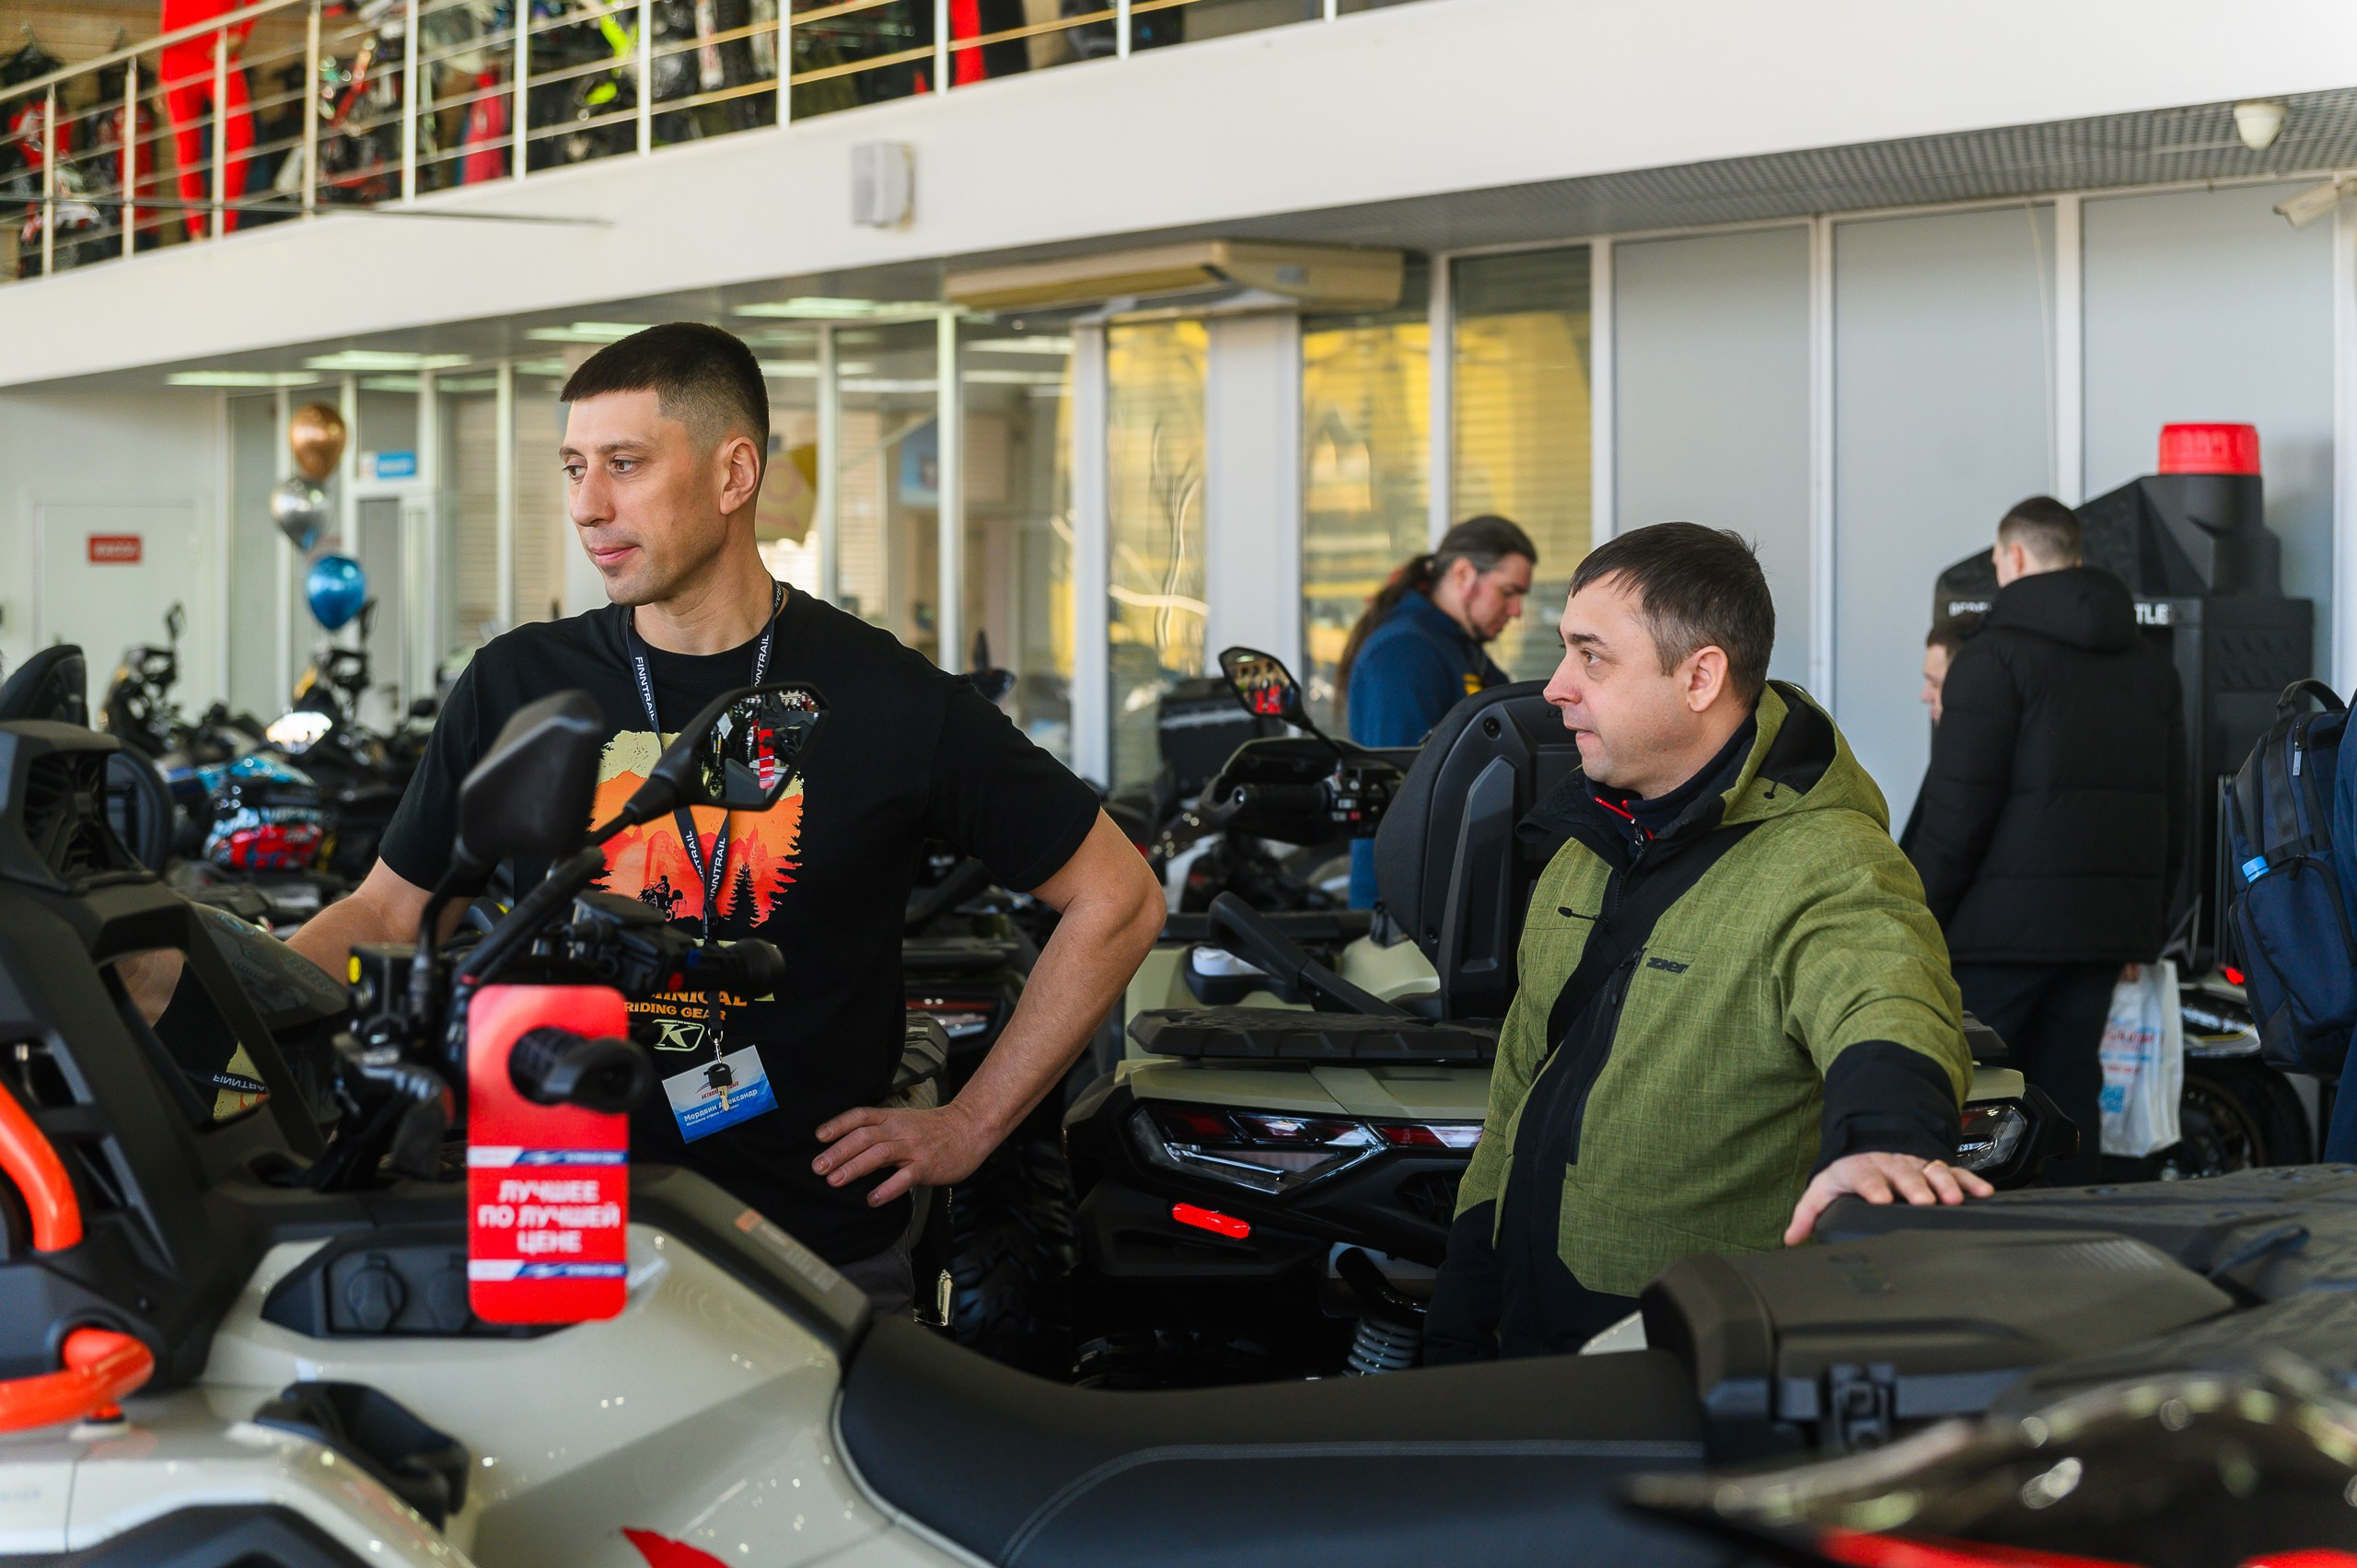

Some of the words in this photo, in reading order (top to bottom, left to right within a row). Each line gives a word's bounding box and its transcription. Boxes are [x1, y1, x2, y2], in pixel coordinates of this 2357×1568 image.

[755, 634, 770, 688] NNTRAIL
[635, 656, 655, 721] FINNTRAIL
[686, 830, 705, 882] NTRAIL
[624, 1002, 677, 1015] RIDING
[683, 1105, 717, 1121] Мордвин
[719, 1089, 758, 1109] Аександр
[497, 1179, 600, 1203] ЛУЧШЕЕ
[477, 1204, 516, 1228] ПО
[517, 1201, 621, 1228] ЛУЧШЕЙ
[516, 1230, 583, 1256] ЦЕНЕ
